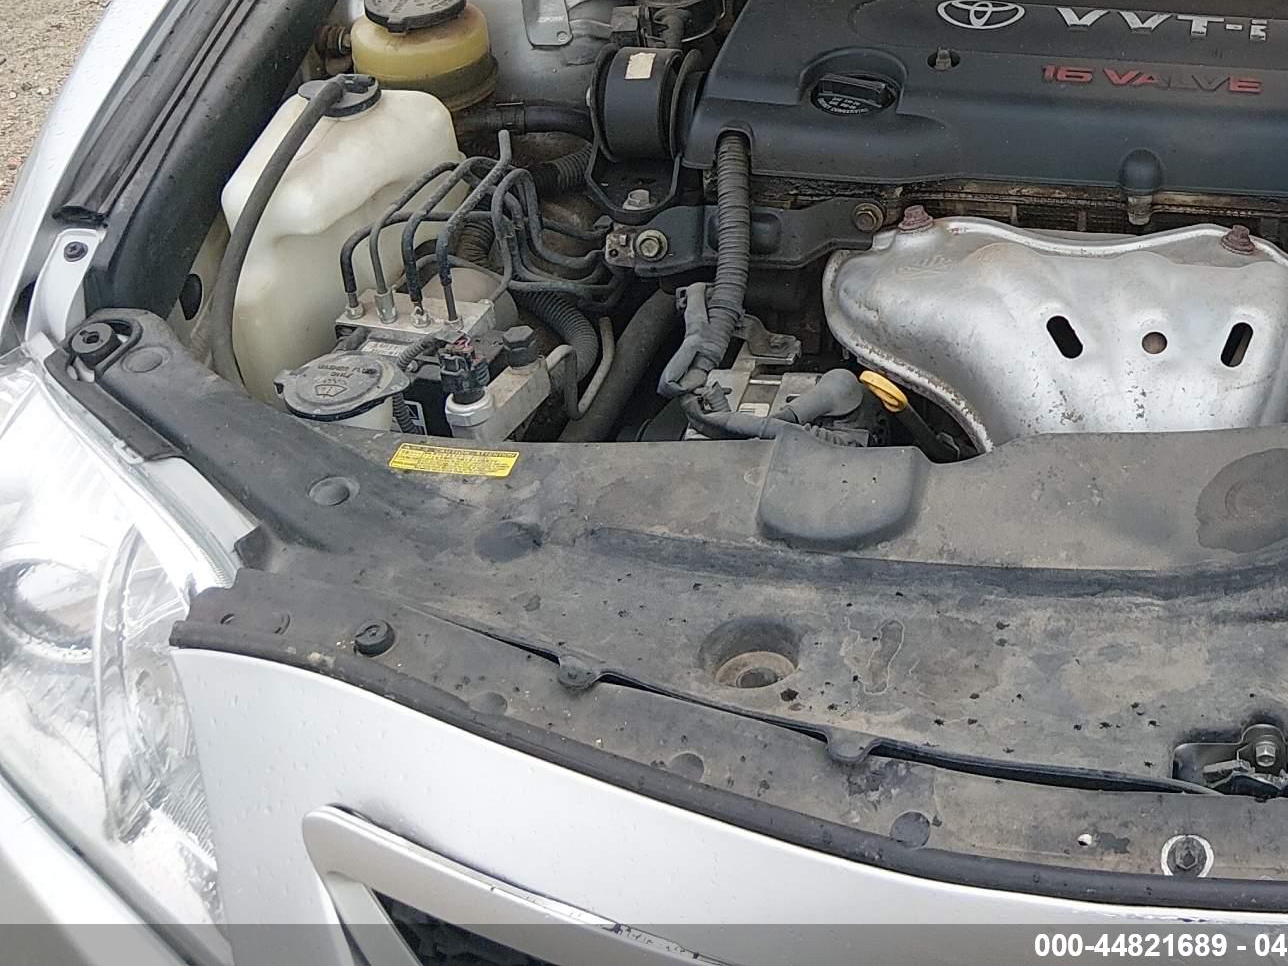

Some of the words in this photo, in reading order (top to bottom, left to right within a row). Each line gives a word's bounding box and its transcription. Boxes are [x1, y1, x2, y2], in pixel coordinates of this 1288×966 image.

[1056, 6, 1268, 42] VVT-i
[1041, 64, 1096, 84] 16
[1103, 67, 1263, 95] VALVE
